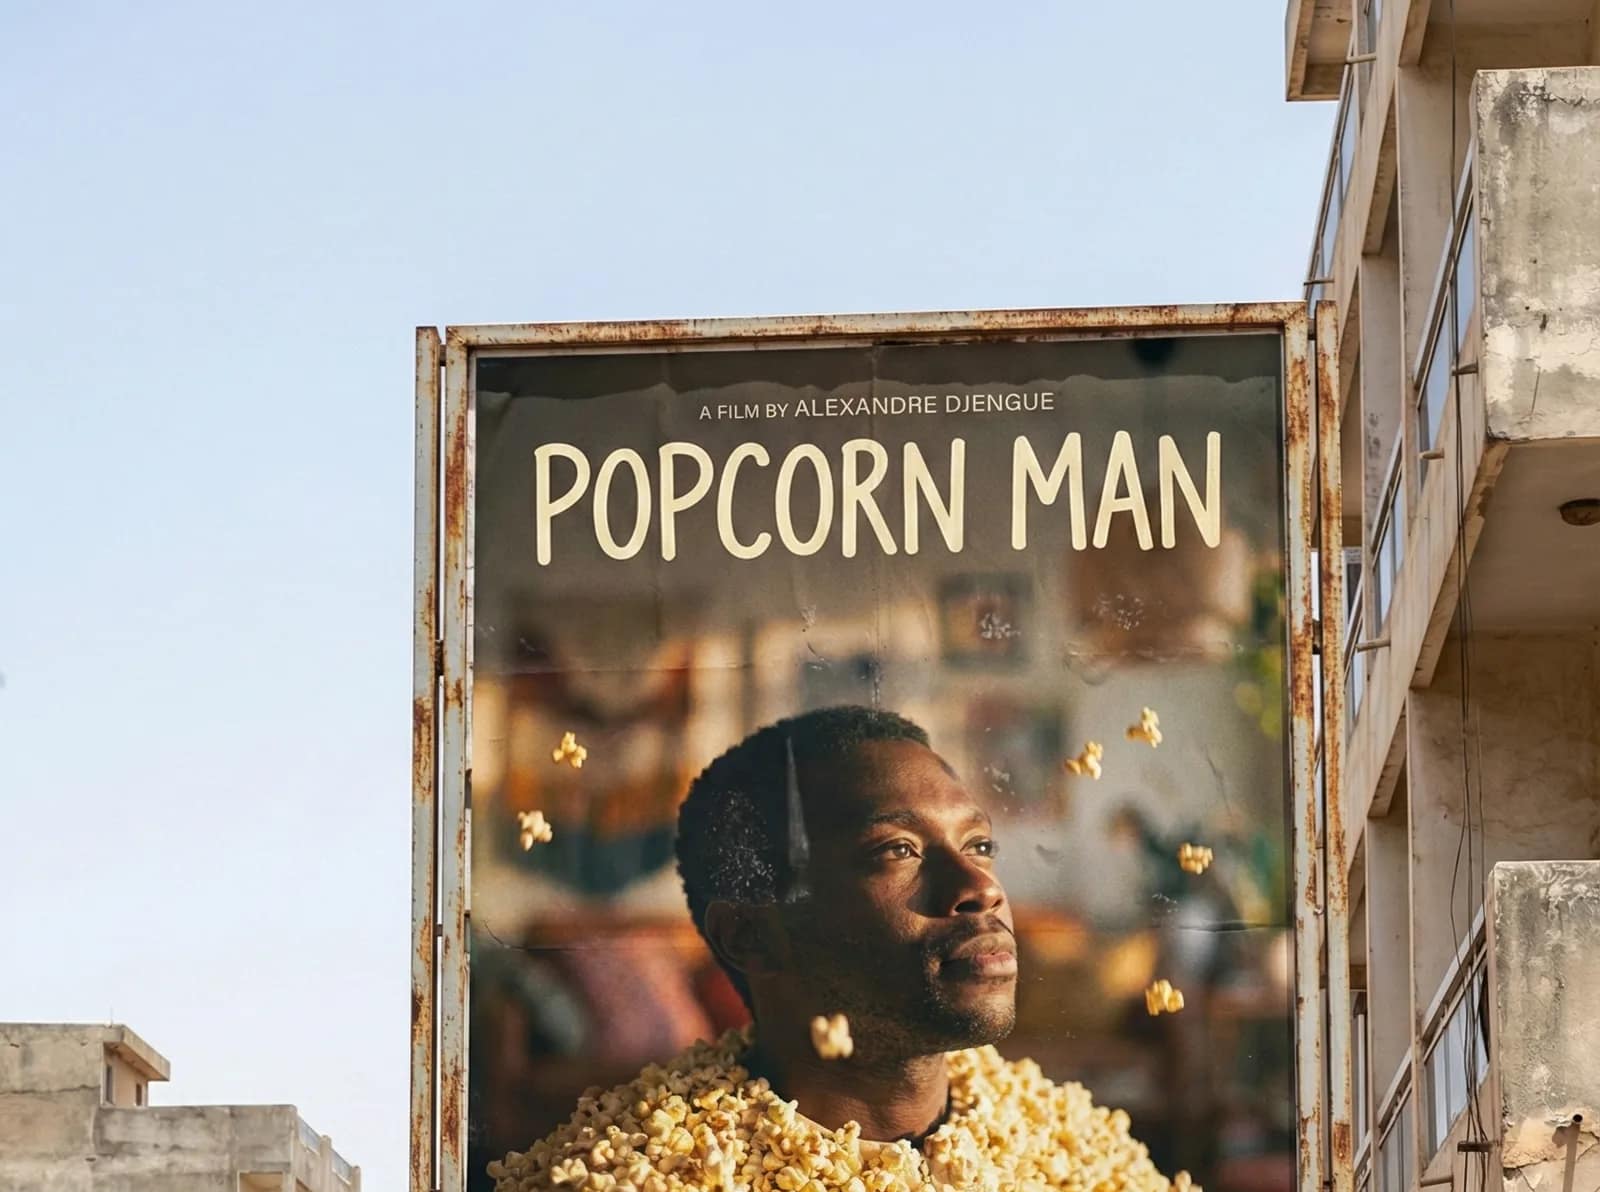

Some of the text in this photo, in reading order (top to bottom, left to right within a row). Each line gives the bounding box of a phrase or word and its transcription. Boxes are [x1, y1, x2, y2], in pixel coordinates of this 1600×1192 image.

[699, 392, 1055, 420] A FILM BY ALEXANDRE DJENGUE
[534, 430, 1221, 565] POPCORN MAN
